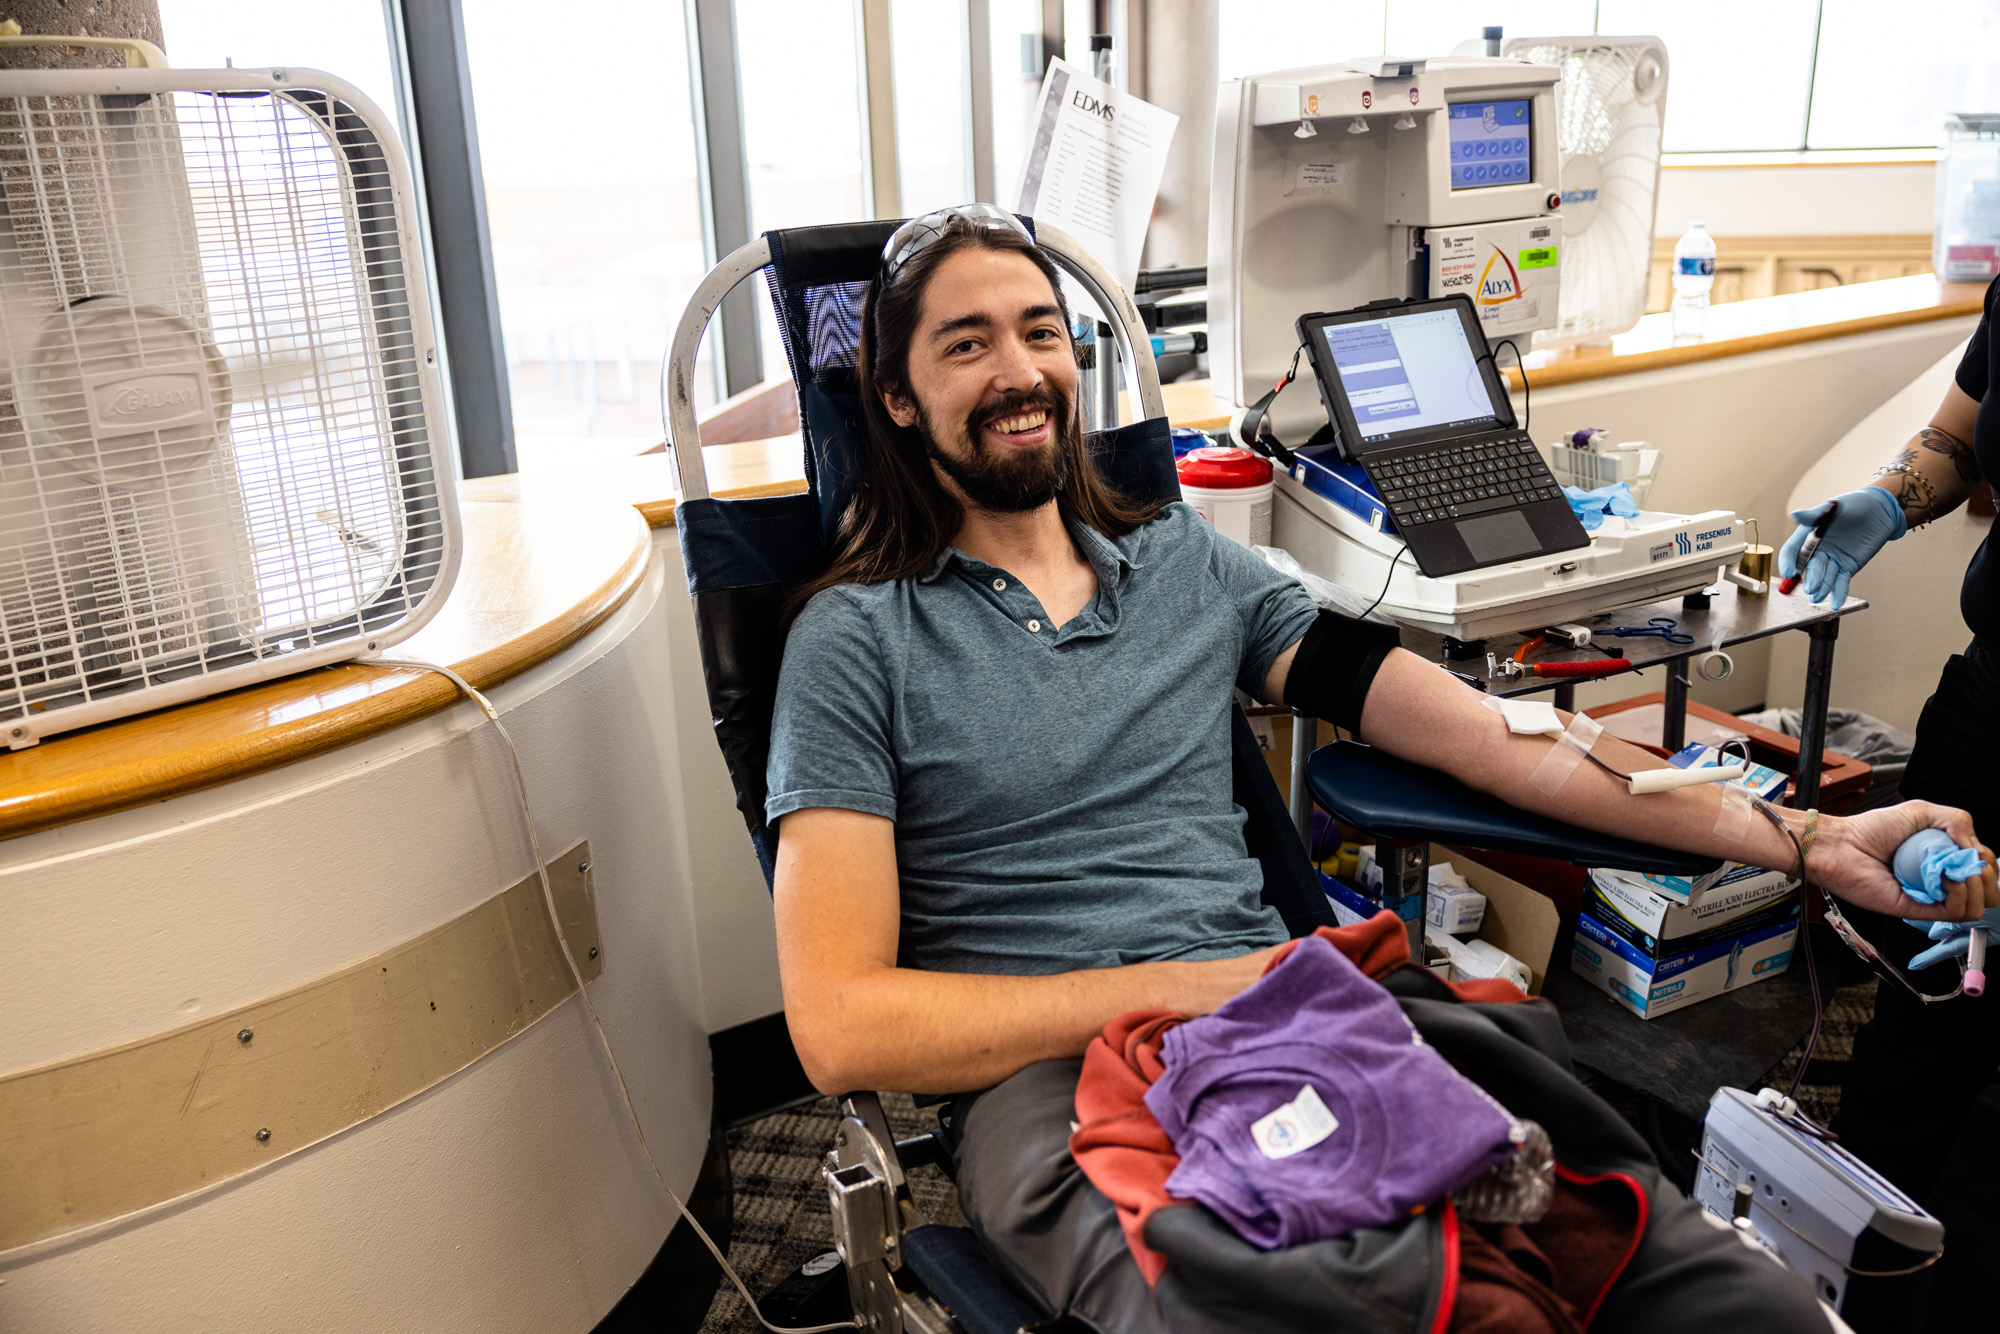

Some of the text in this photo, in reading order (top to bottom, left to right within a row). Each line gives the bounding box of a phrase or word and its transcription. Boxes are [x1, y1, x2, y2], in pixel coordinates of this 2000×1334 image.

[1072, 90, 1116, 122] EDMS
[1481, 279, 1512, 296] ALYX
[1696, 527, 1732, 542] FRESENIUS
[1696, 541, 1713, 552] KABI
[1691, 901, 1724, 916] NYTRILE
[1724, 893, 1743, 906] X300
[1745, 885, 1775, 899] ELECTRA
[1580, 920, 1618, 949] CRITERION
[1658, 954, 1696, 972] CRITERION
[1653, 980, 1683, 998] NITRILE
